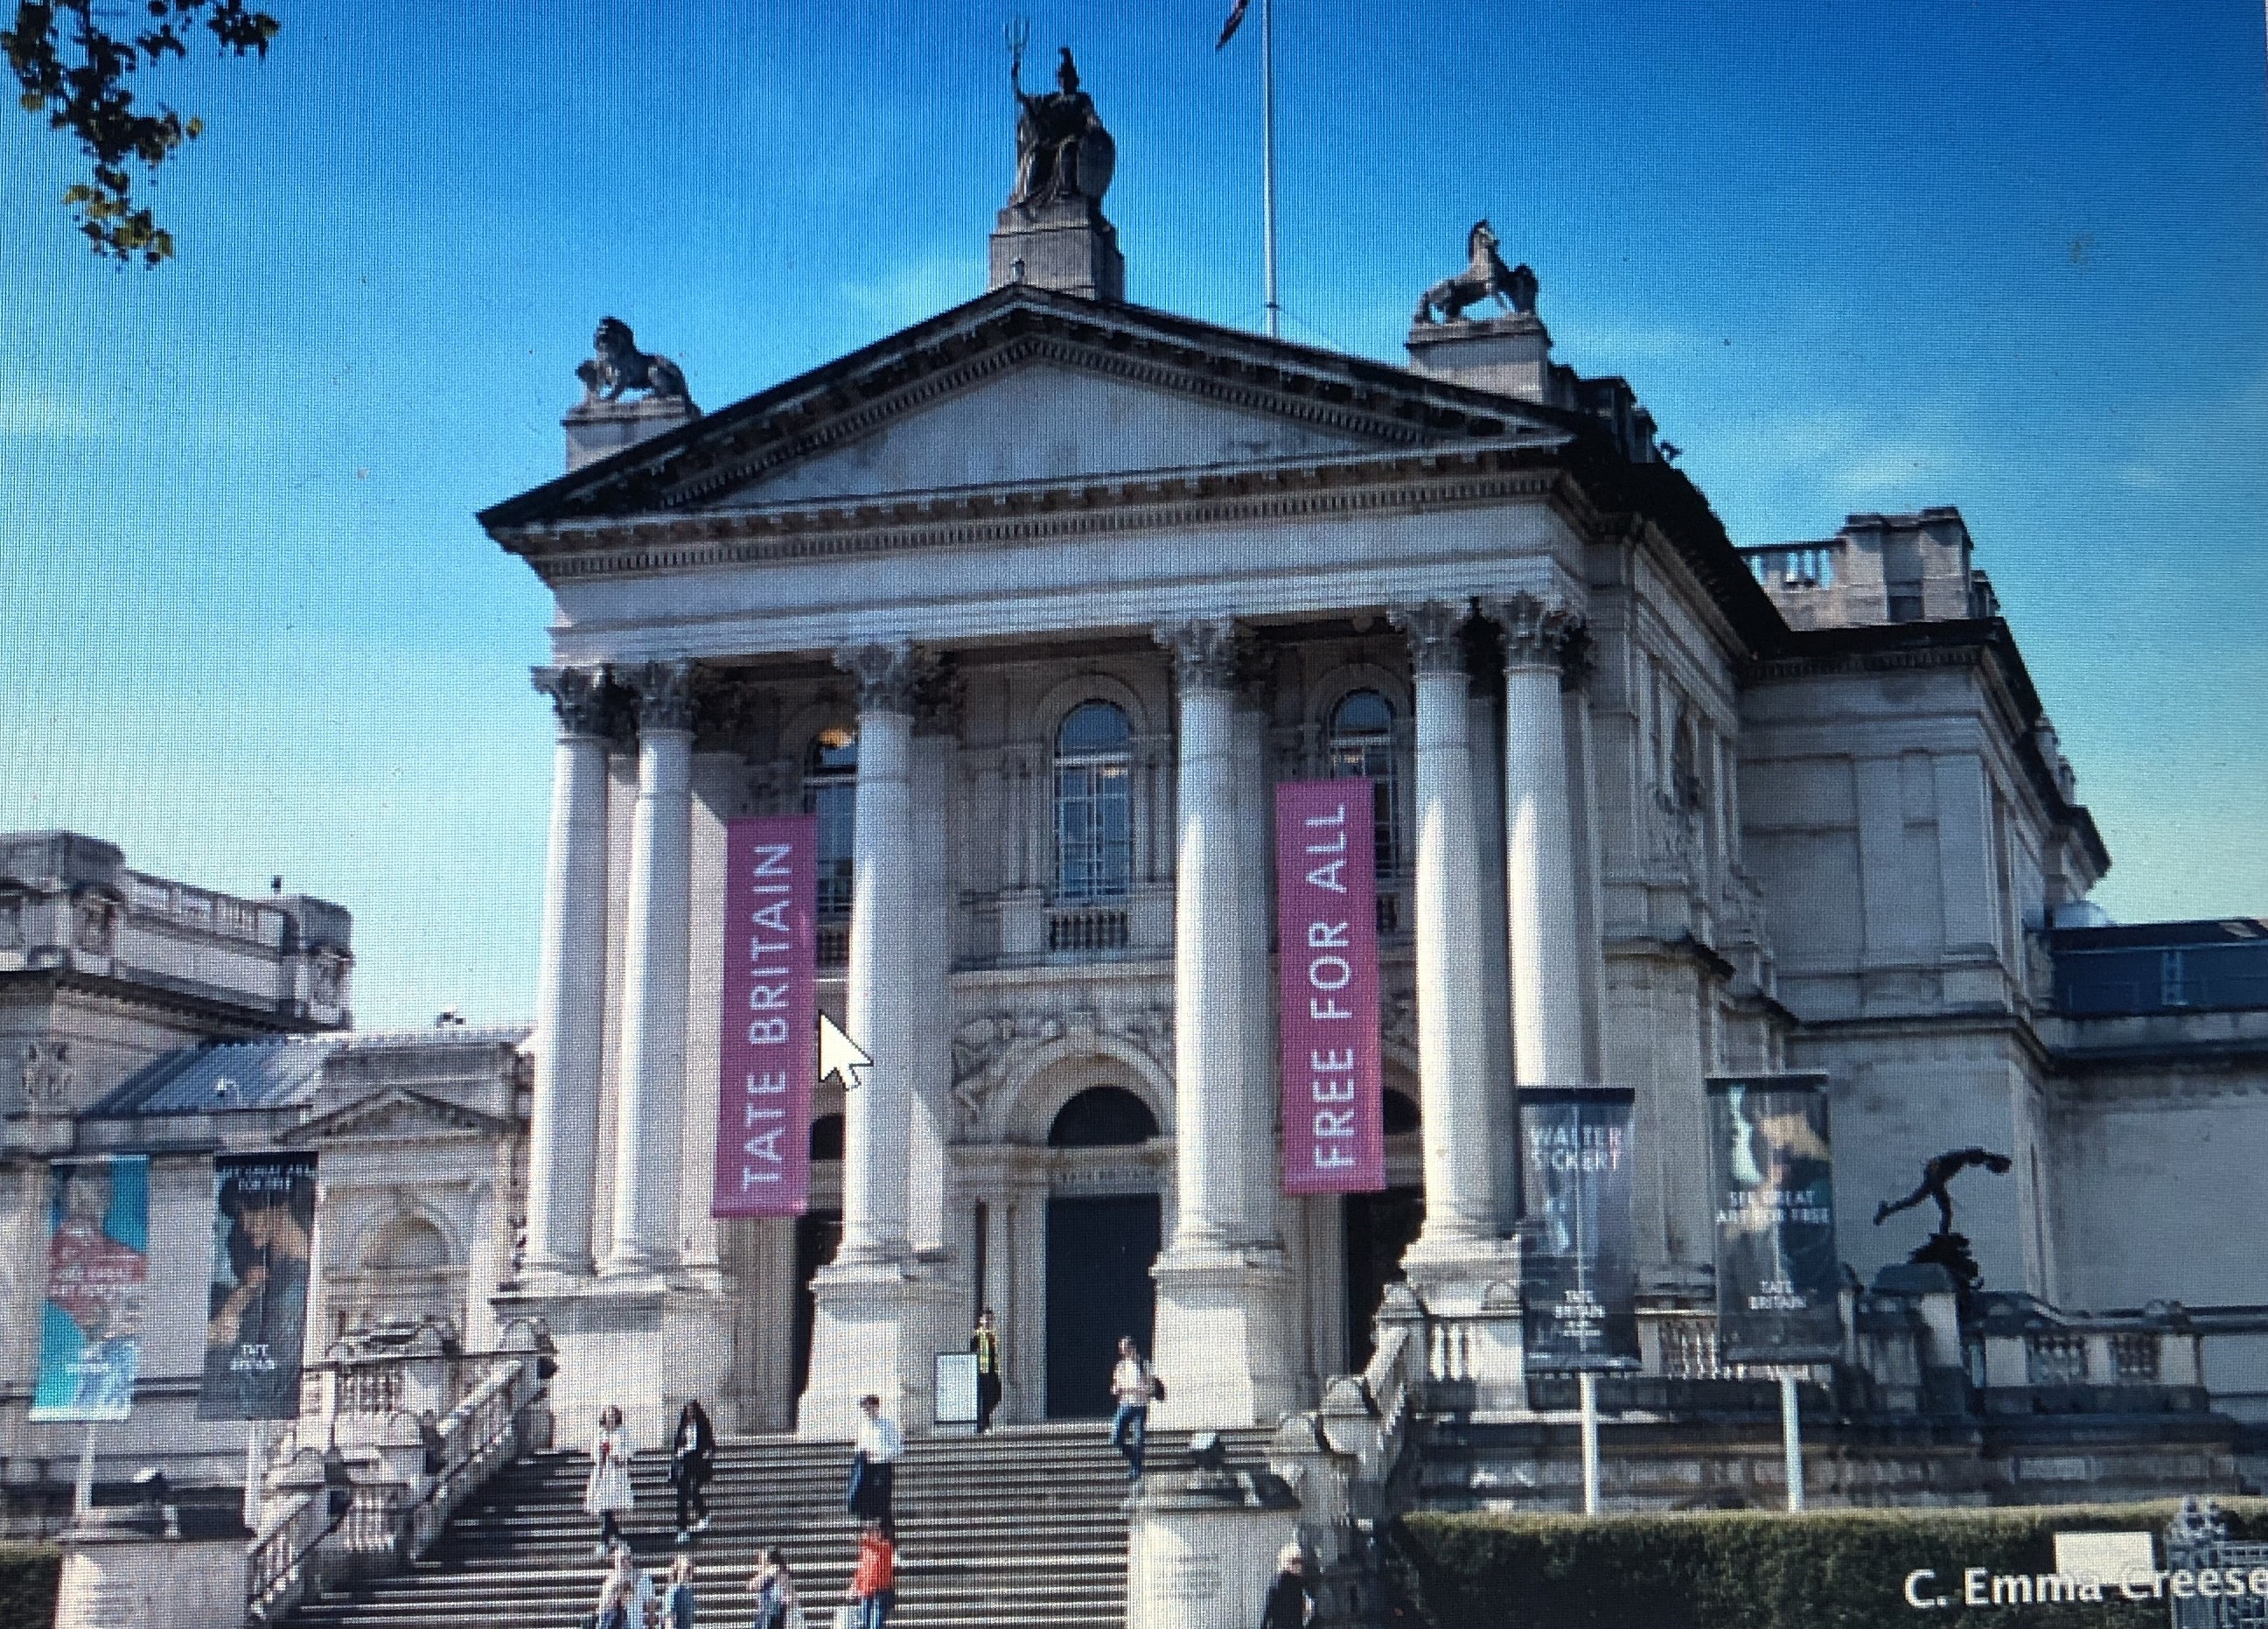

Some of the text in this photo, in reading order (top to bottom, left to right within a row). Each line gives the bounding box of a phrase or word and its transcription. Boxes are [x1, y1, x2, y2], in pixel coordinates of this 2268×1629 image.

[742, 843, 792, 1192] TATE BRITAIN
[1304, 802, 1356, 1170] FREE FOR ALL
